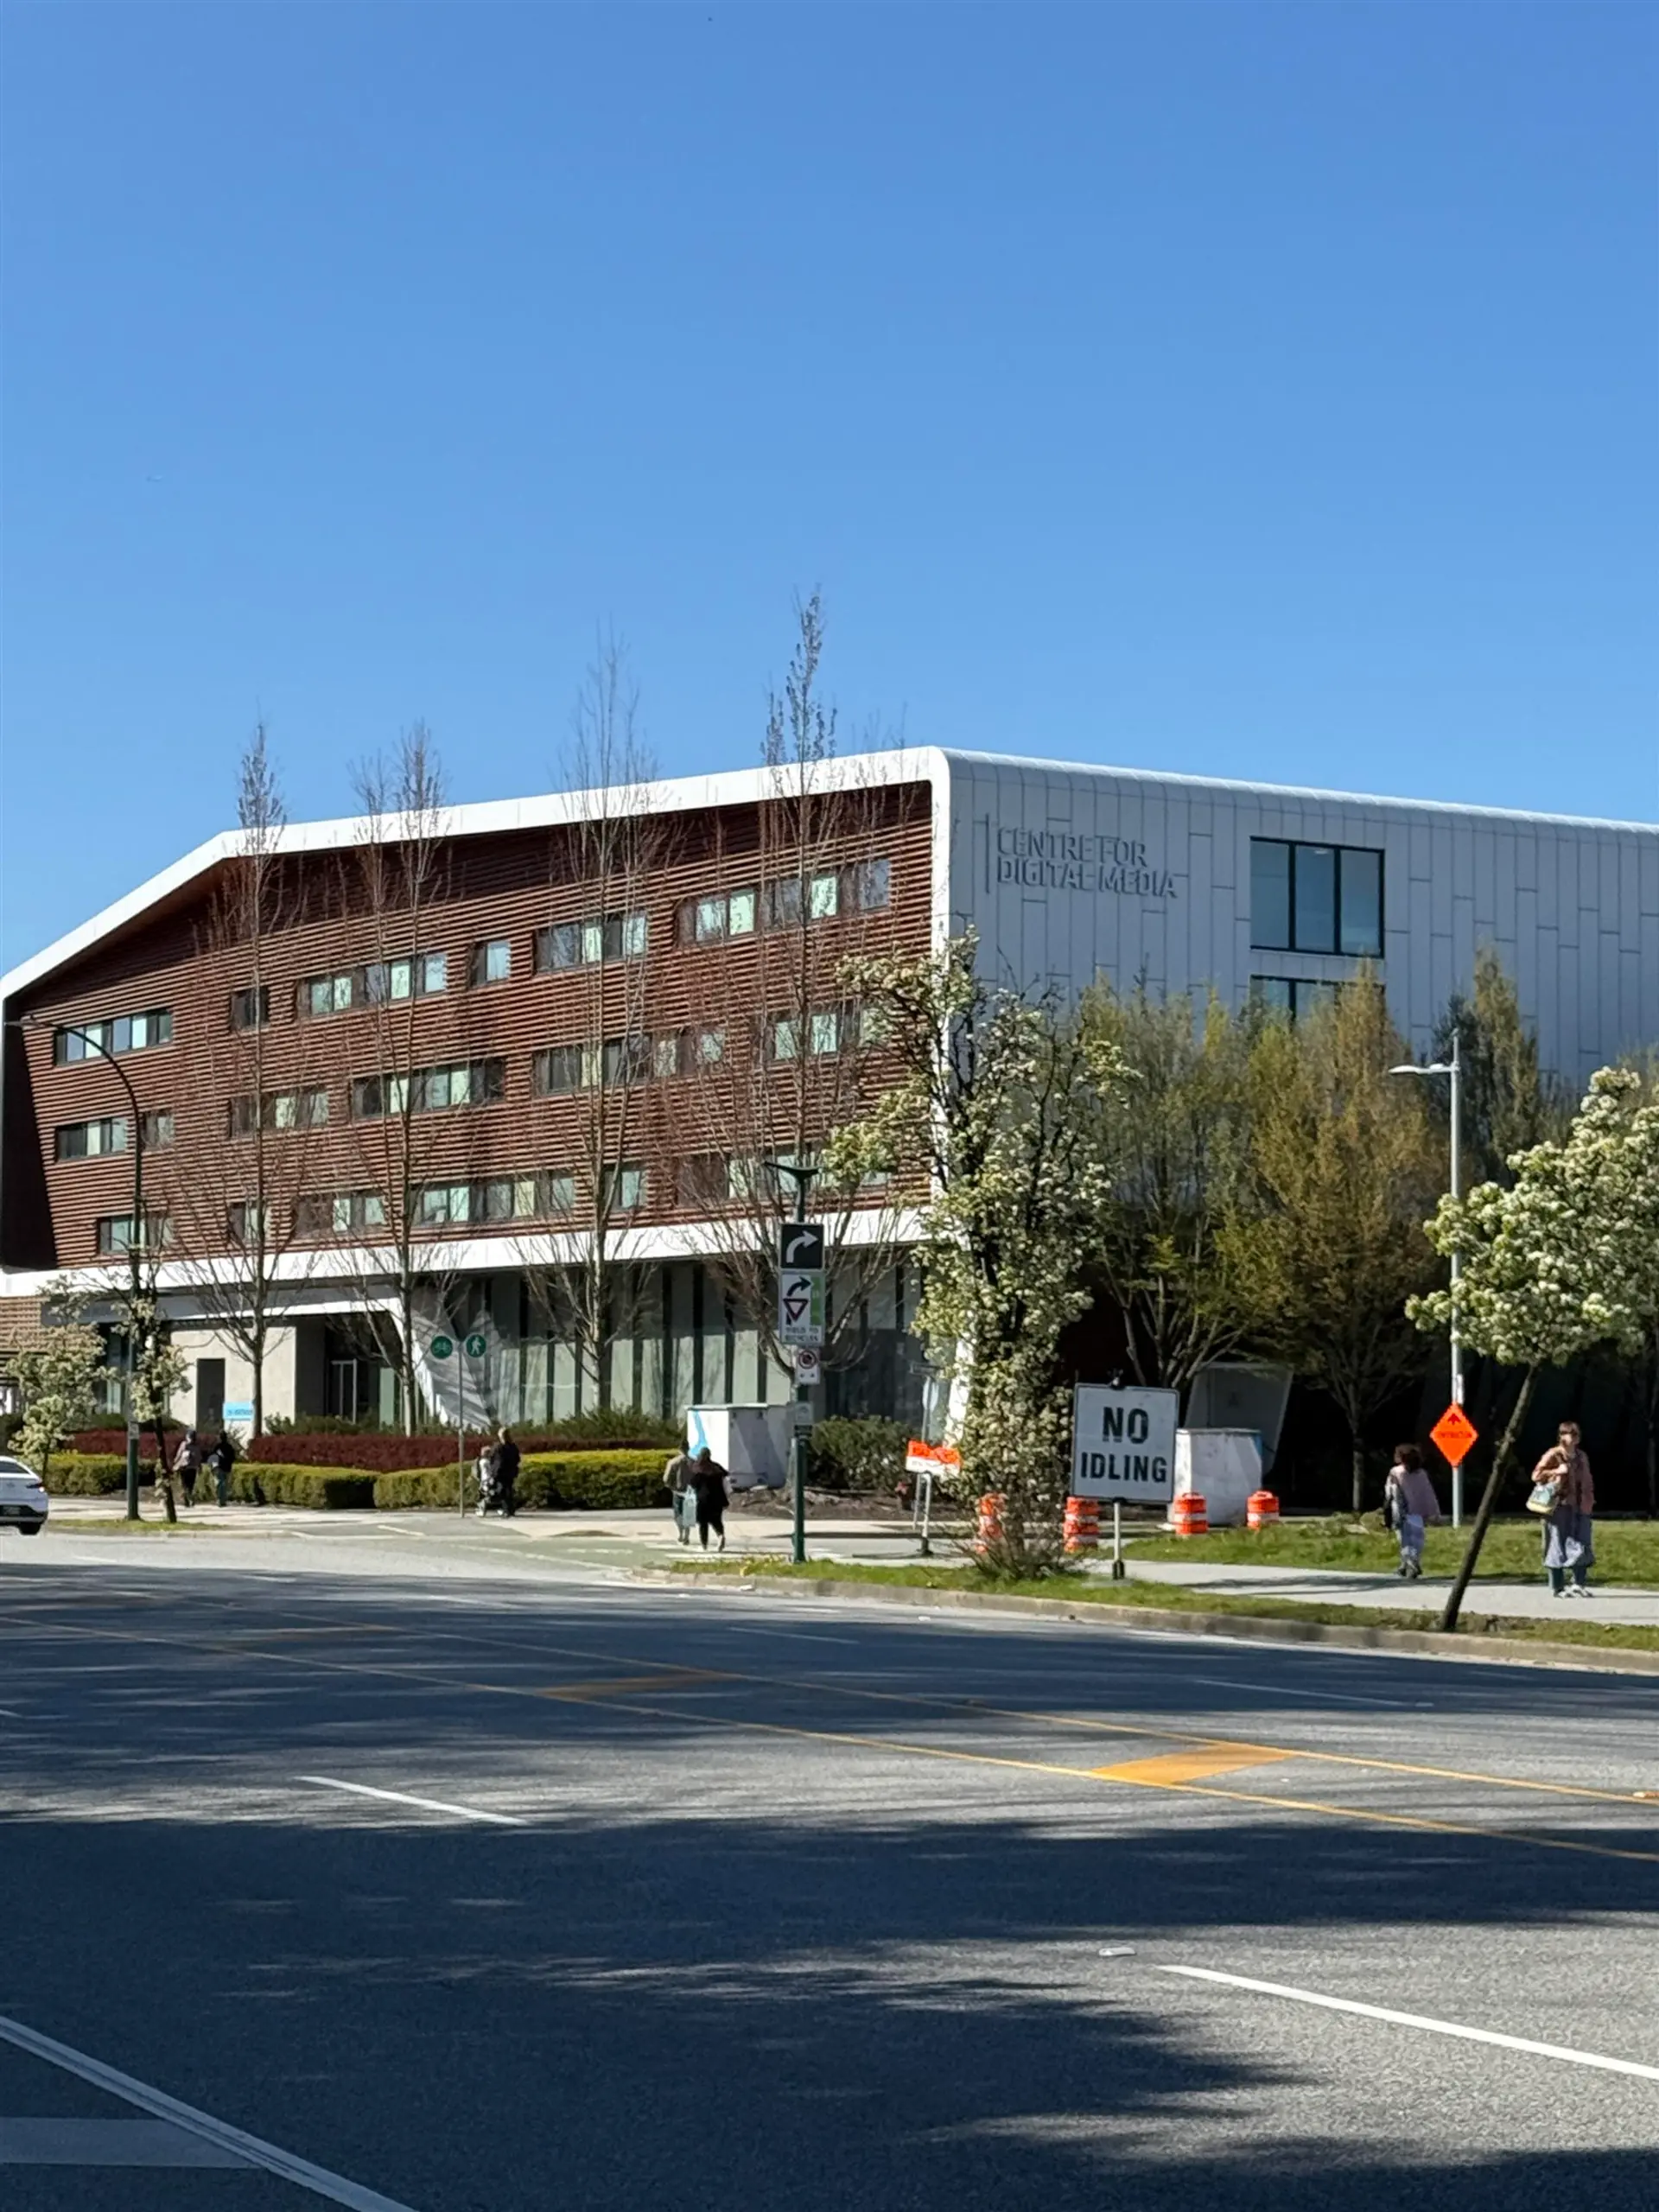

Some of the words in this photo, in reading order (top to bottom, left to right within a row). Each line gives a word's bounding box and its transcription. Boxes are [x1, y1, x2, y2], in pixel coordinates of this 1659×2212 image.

[997, 827, 1094, 862] CENTRE
[1098, 835, 1147, 868] FOR
[997, 856, 1094, 891] DIGITAL
[1098, 865, 1178, 898] MEDIA
[1103, 1407, 1148, 1444] NO
[1081, 1452, 1167, 1483] IDLING
